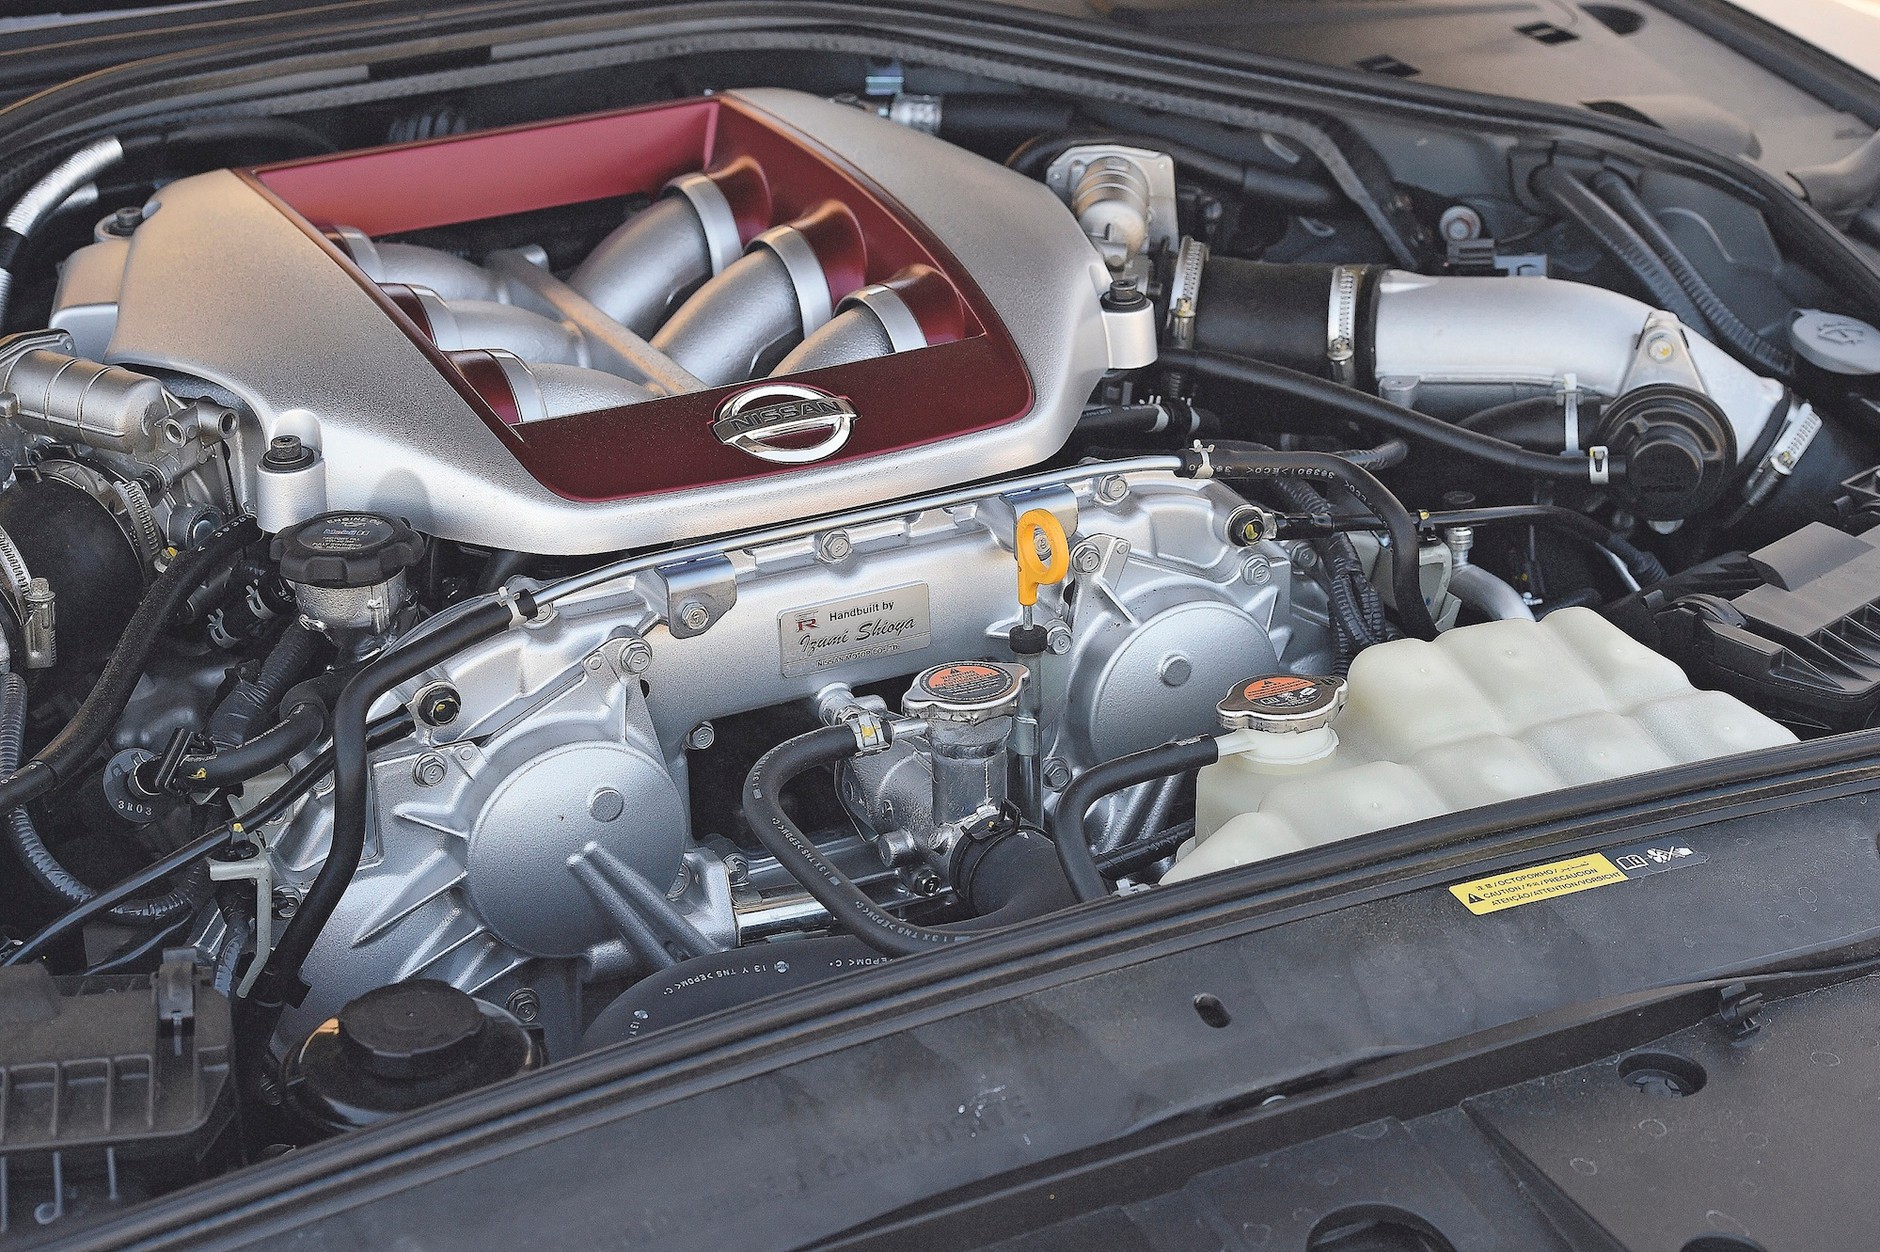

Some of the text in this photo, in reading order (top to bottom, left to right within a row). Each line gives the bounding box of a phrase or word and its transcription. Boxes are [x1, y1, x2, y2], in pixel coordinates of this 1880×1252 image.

[729, 401, 843, 431] NISSAN
[829, 601, 895, 622] Handbuilt by
[800, 617, 916, 656] Izumi Shioya
[817, 656, 844, 667] NISSAN
[118, 800, 152, 816] 3R03
[1483, 886, 1521, 899] CAUTION
[716, 966, 737, 978] TNS
